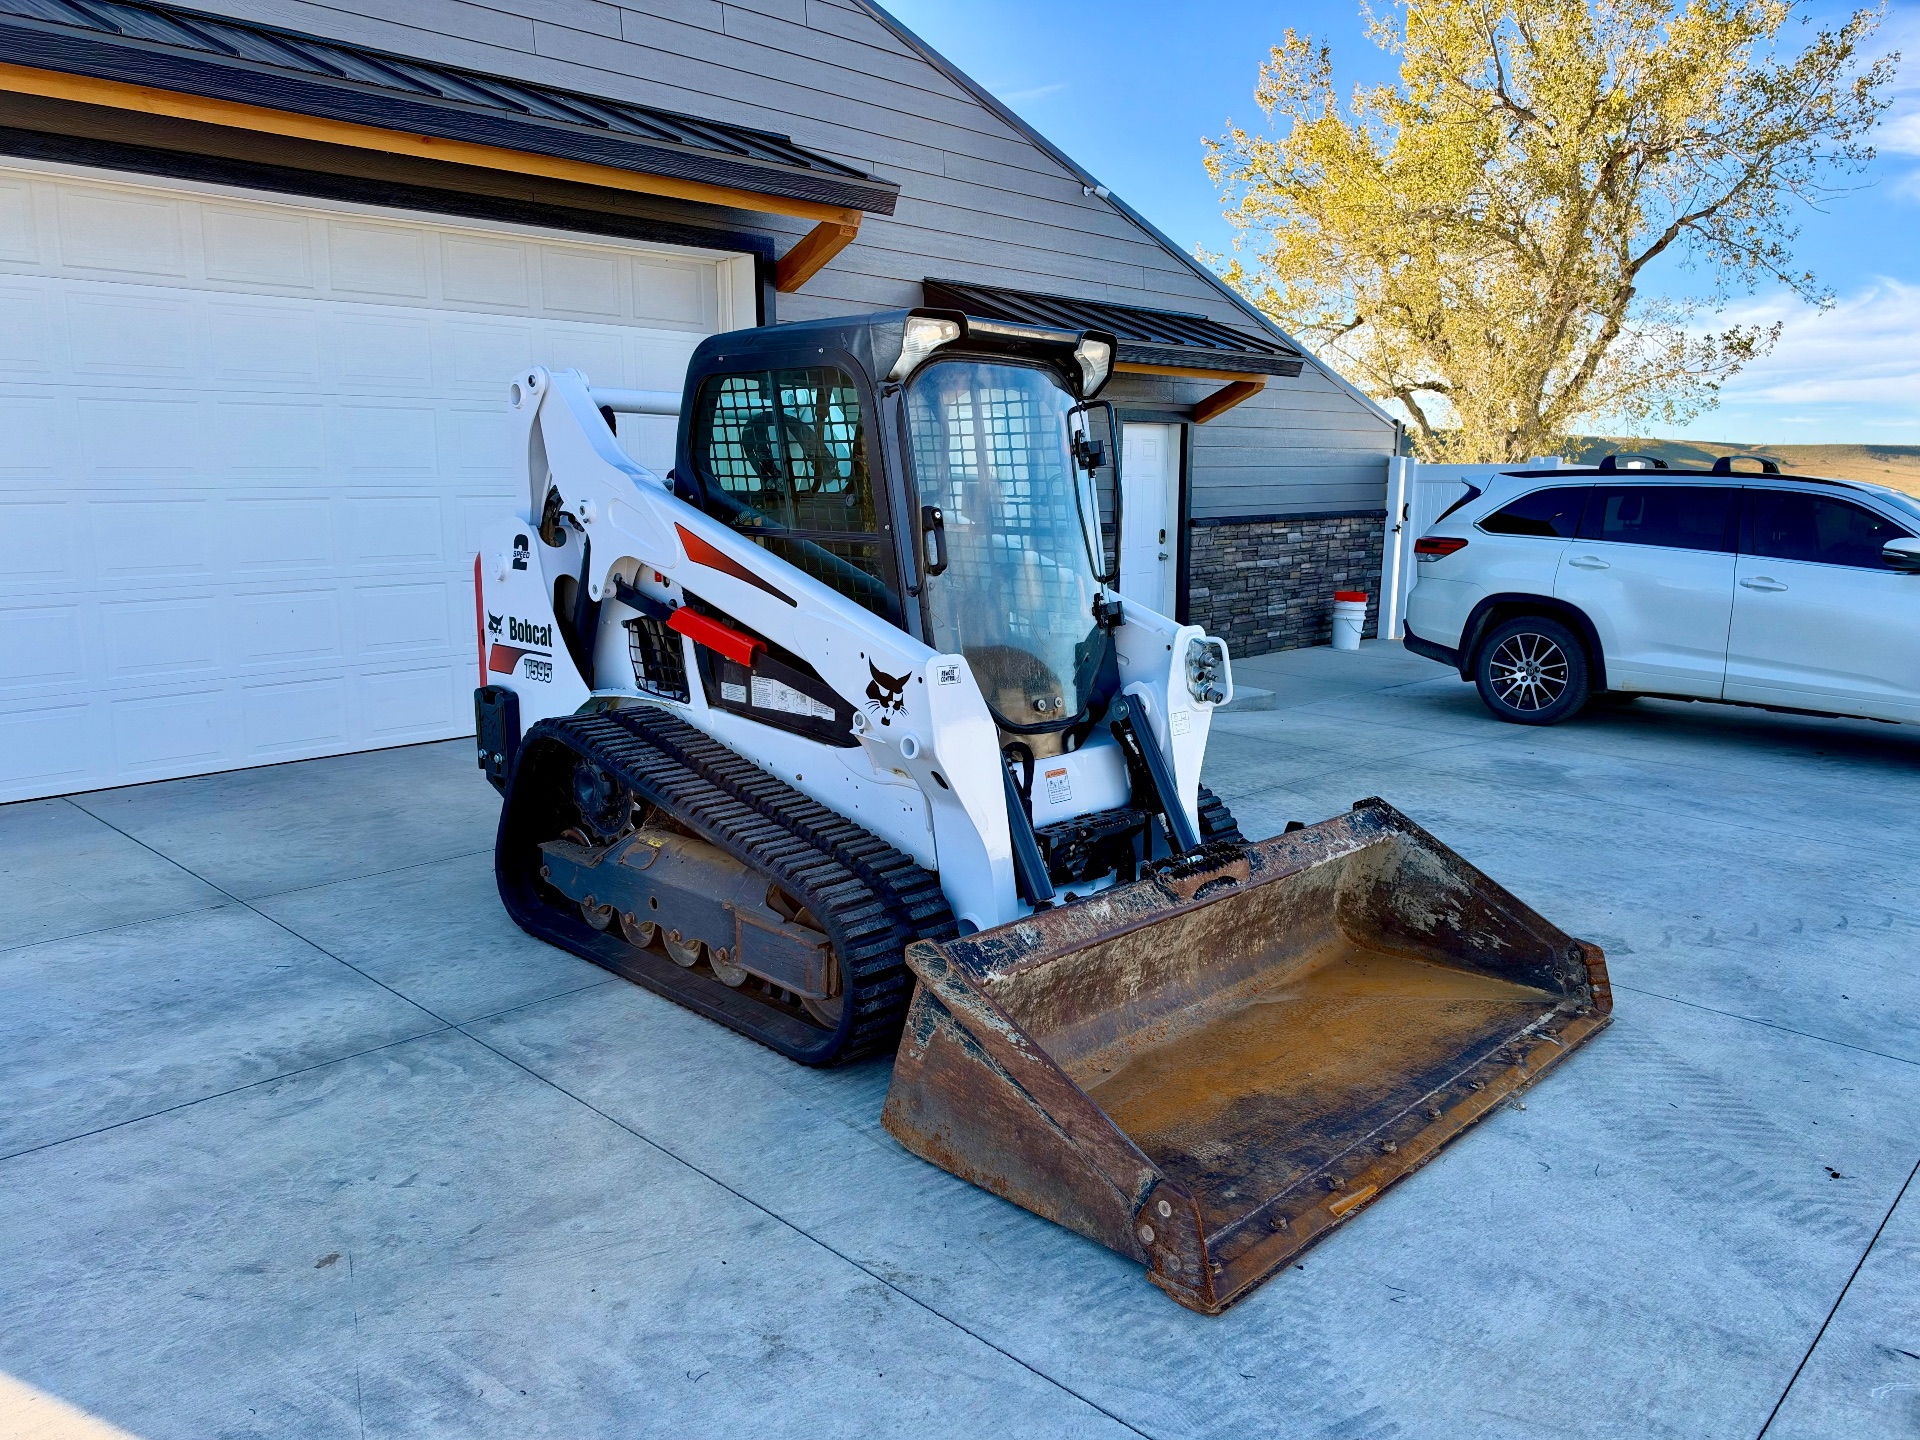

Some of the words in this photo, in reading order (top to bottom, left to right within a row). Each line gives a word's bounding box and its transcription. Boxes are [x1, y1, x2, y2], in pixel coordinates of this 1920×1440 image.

[513, 551, 530, 559] SPEED
[509, 616, 552, 648] Bobcat
[524, 658, 552, 683] T595
